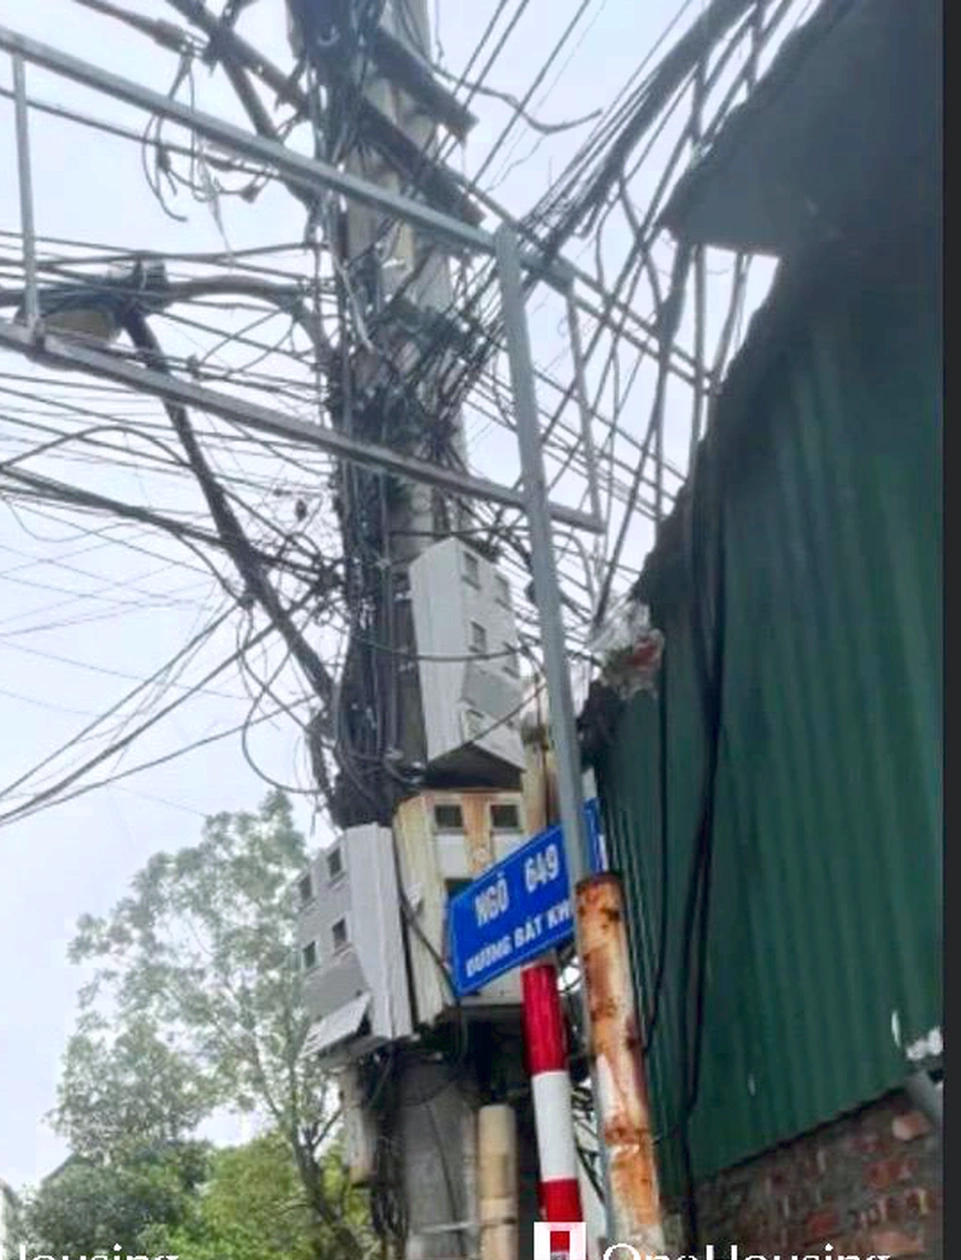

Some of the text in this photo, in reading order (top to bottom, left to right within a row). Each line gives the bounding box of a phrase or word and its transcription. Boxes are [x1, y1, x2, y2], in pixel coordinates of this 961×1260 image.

[474, 843, 560, 927] NGÕ 649
[547, 900, 572, 929] KH
